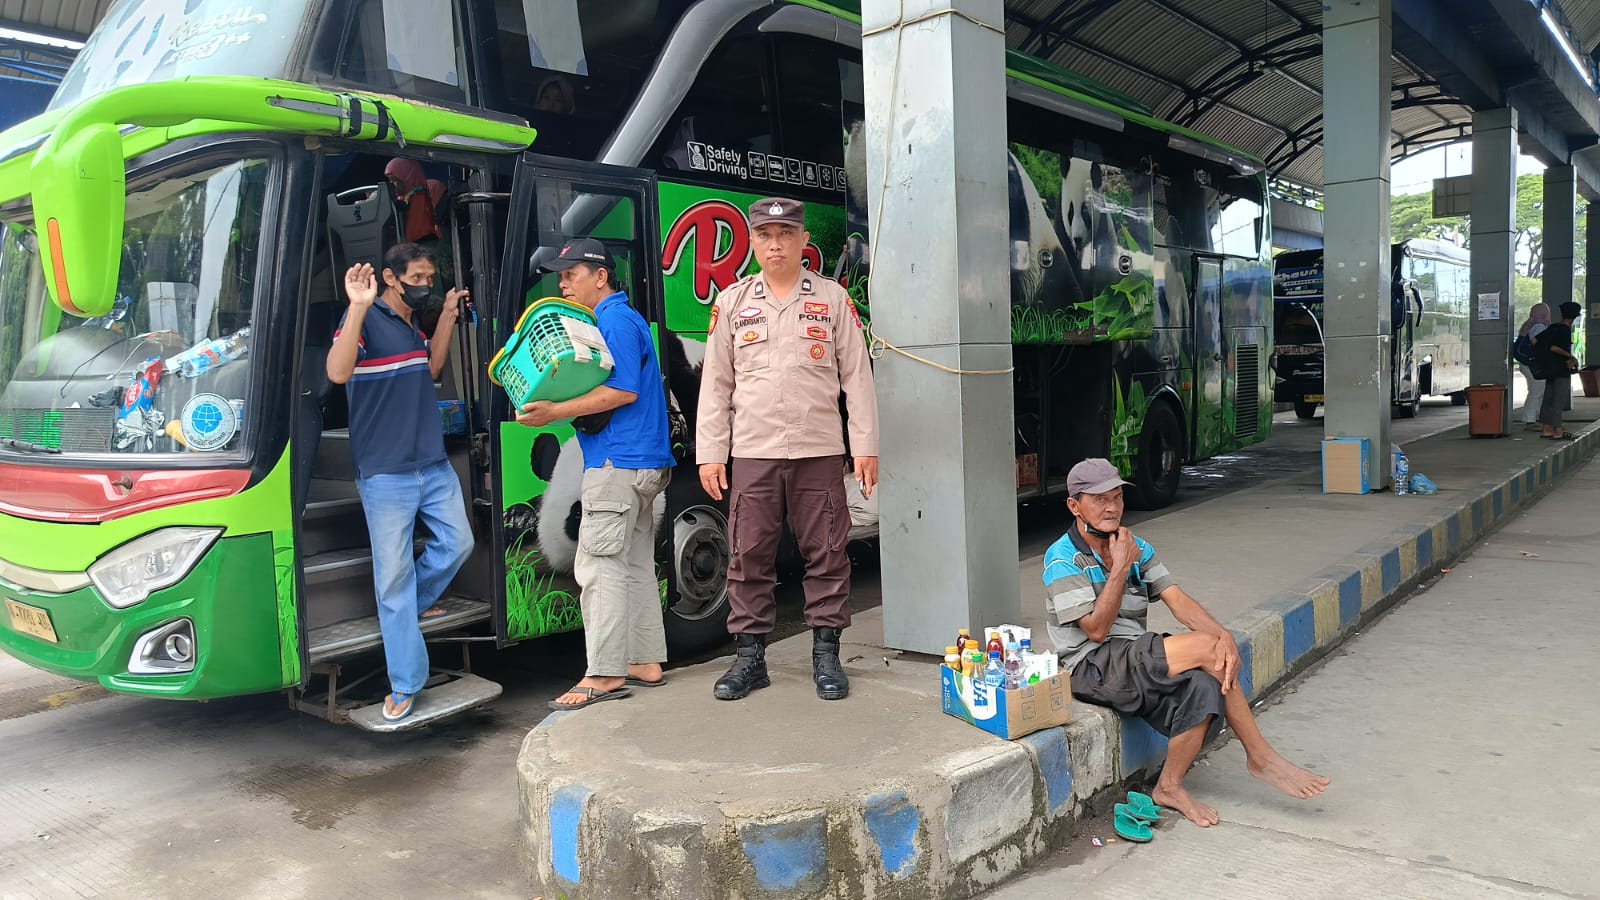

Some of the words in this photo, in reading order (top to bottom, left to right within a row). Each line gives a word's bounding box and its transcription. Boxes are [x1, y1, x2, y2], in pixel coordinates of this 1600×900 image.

[707, 145, 741, 166] Safely
[708, 159, 747, 180] Driving
[798, 313, 832, 324] POLRI
